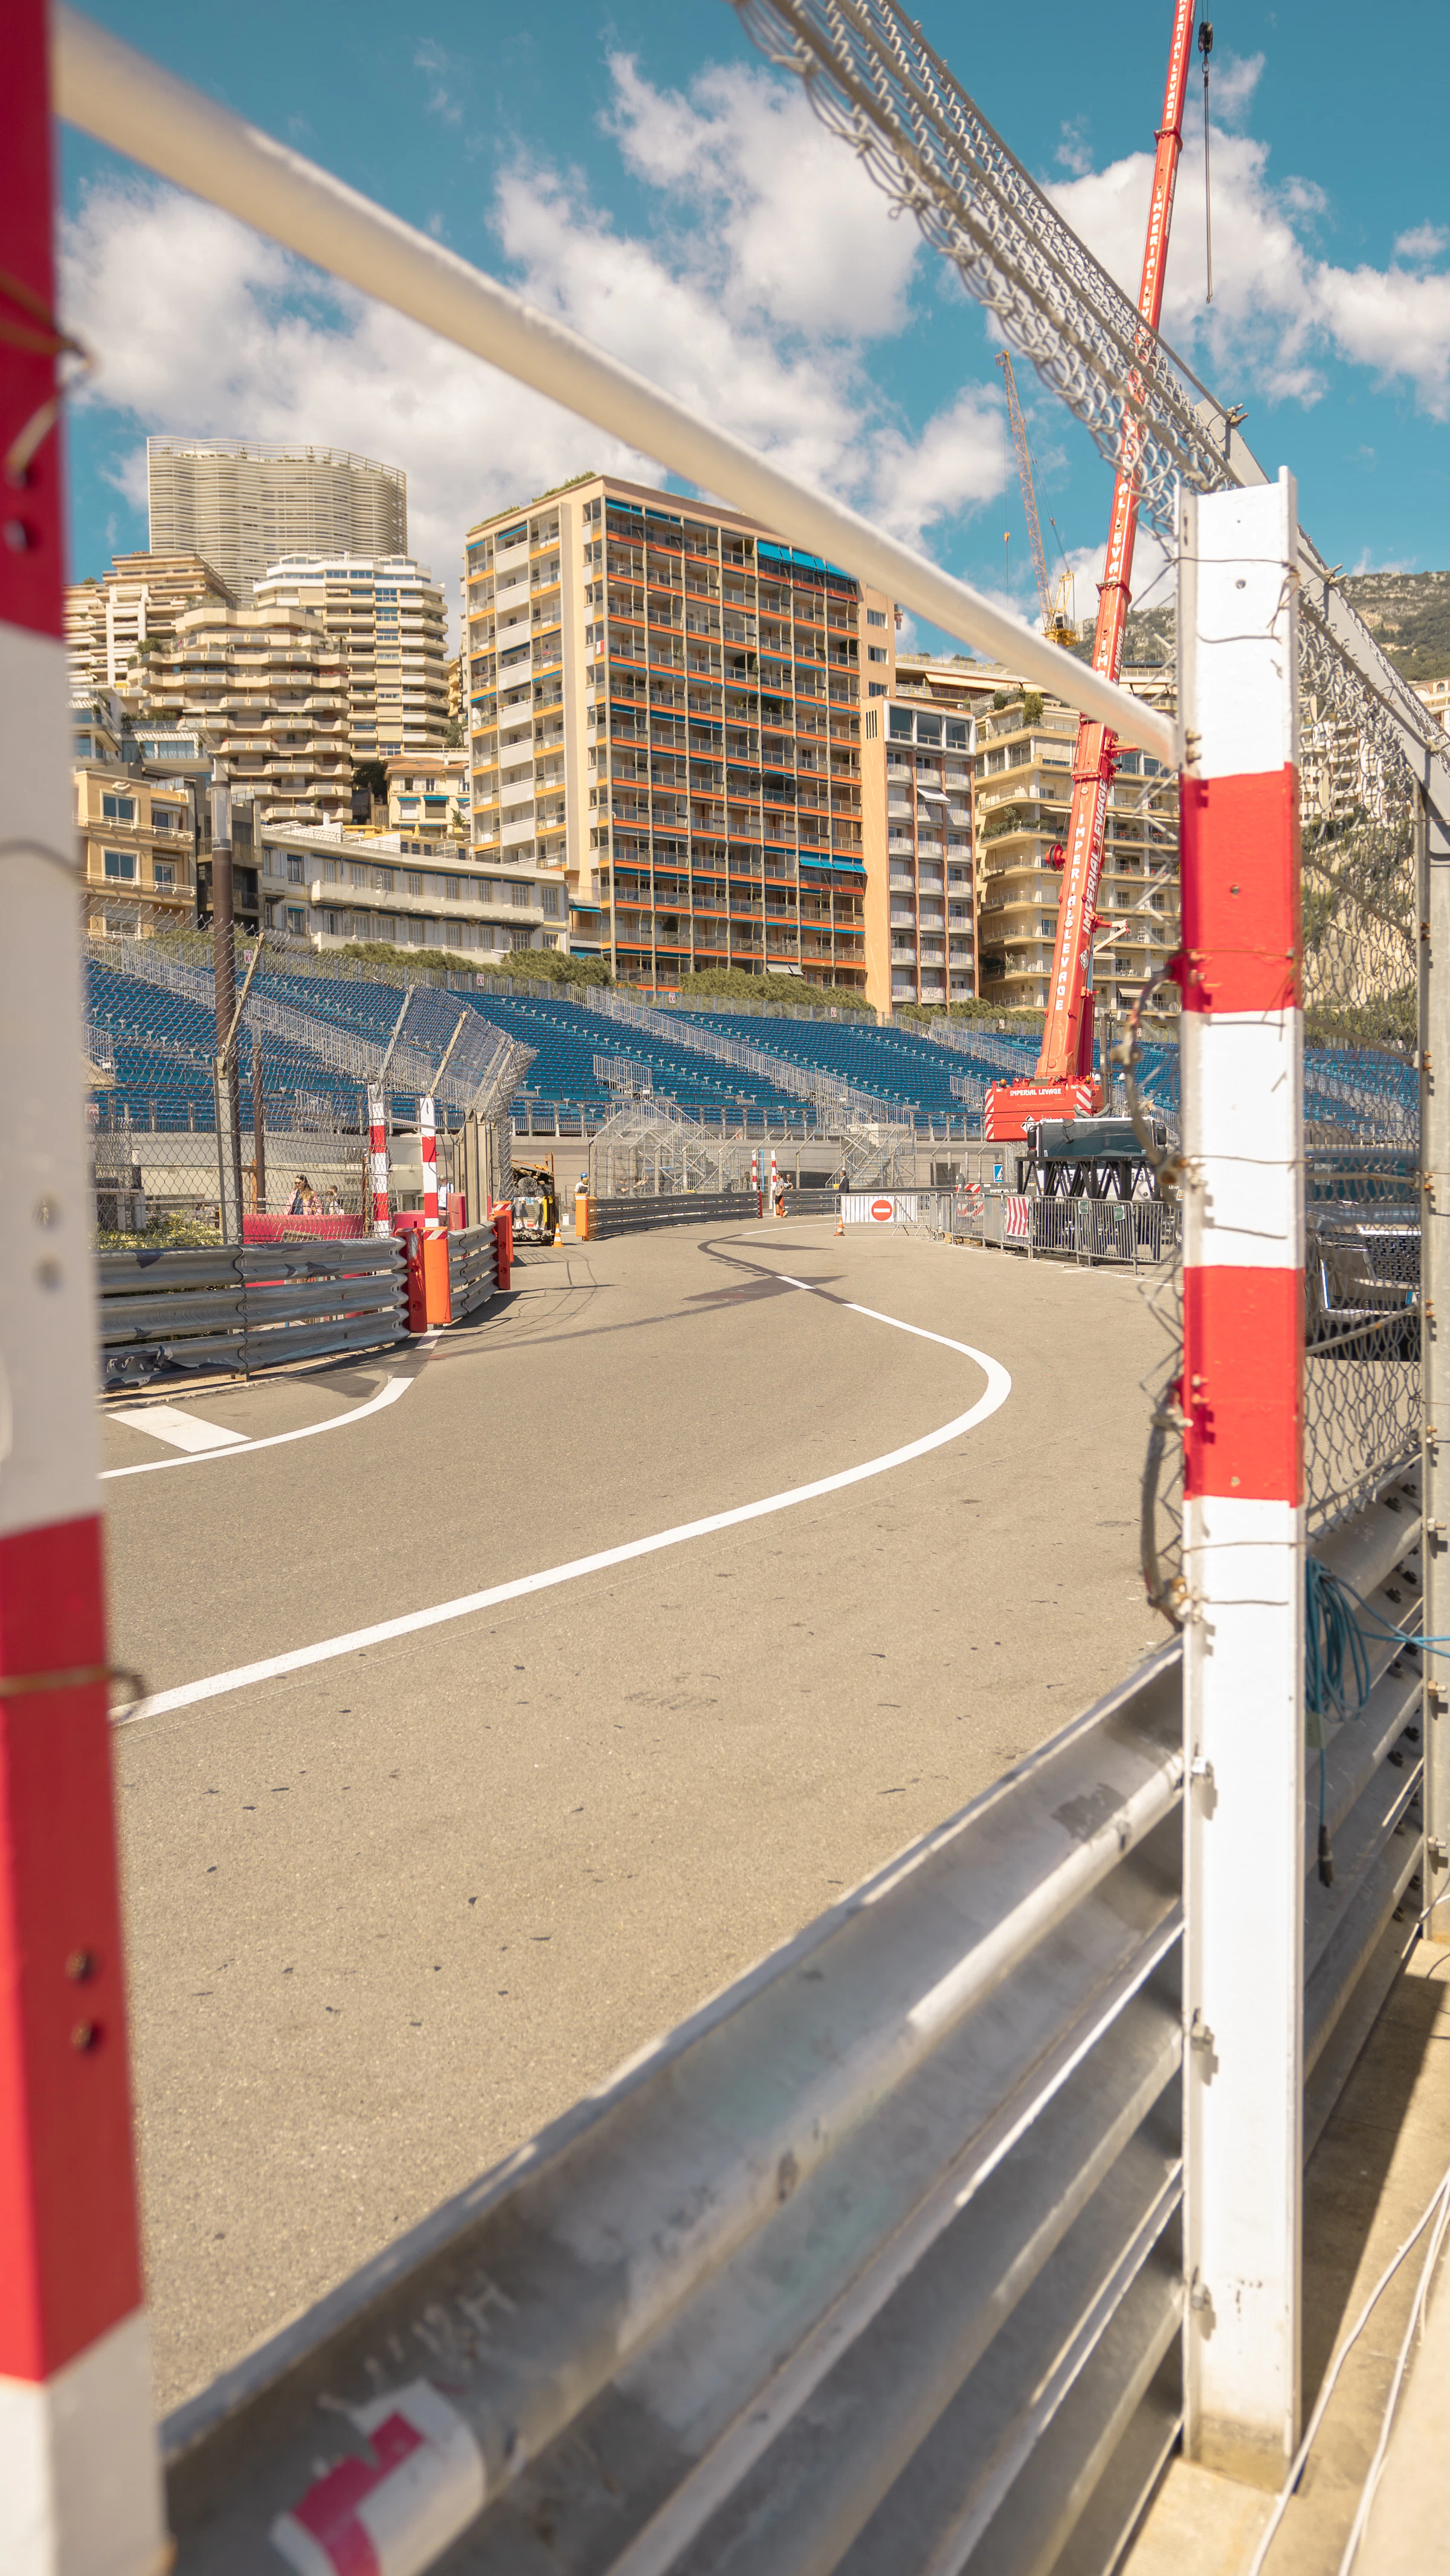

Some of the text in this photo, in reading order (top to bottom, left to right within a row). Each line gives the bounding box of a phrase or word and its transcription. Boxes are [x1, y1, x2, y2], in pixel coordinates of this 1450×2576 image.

[1166, 64, 1178, 120] LEVAGE
[1146, 191, 1162, 279] IMPERIAL
[1113, 625, 1124, 675] LEVAGE
[1093, 778, 1107, 847] LEVAGE
[1055, 814, 1086, 1010] IMPERIAL LEVAGE
[1083, 851, 1099, 936] IMPERIAL
